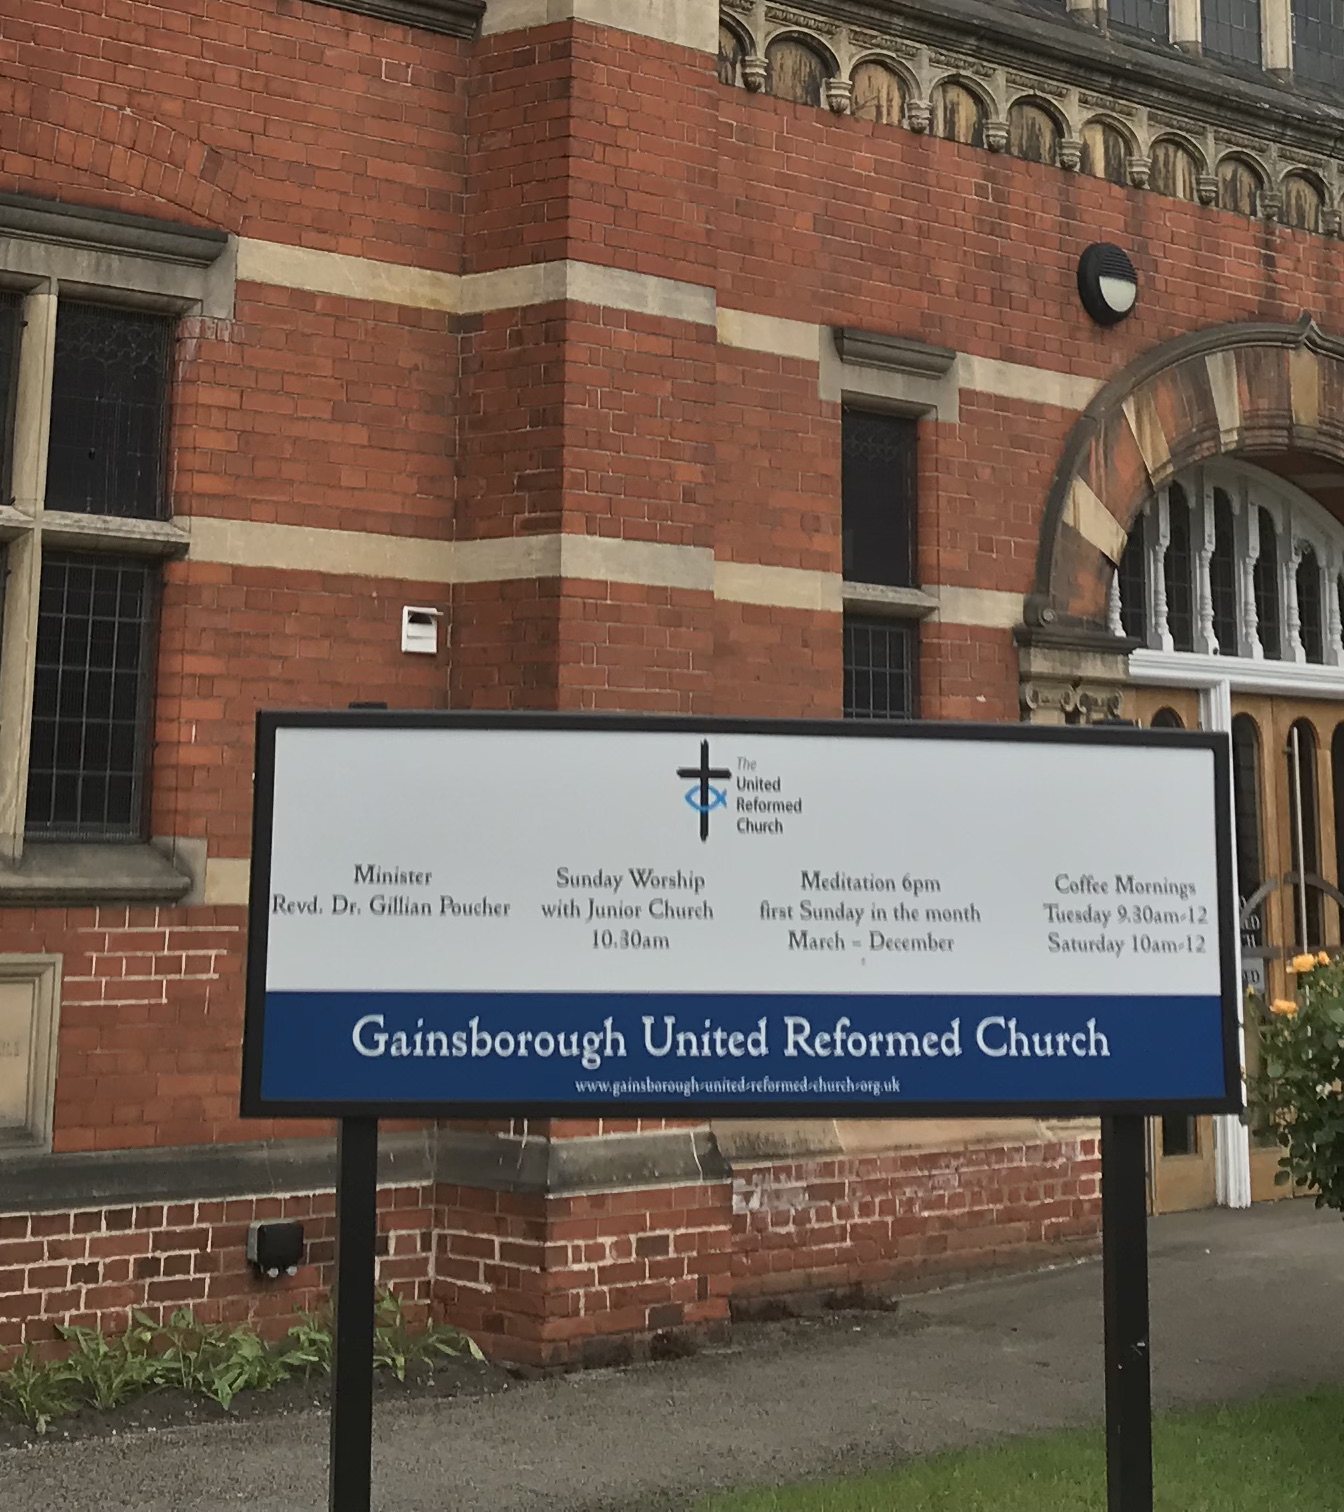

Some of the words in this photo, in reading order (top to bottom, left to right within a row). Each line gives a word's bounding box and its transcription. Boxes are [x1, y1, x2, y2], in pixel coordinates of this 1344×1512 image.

[736, 755, 757, 771] The
[736, 775, 781, 793] United
[736, 795, 802, 814] Reformed
[736, 816, 783, 835] Church
[353, 863, 433, 886] Minister
[556, 865, 624, 894] Sunday
[627, 867, 706, 895] Worship
[800, 869, 897, 892] Meditation
[901, 872, 942, 897] 6pm
[1054, 872, 1109, 895] Coffee
[1114, 874, 1197, 901] Mornings
[272, 893, 323, 916] Revd.
[331, 893, 362, 916] Dr.
[368, 893, 433, 917] Gillian
[439, 894, 511, 917] Poucher
[540, 898, 581, 919] with
[584, 897, 643, 925] Junior
[648, 897, 714, 920] Church
[759, 899, 794, 921] first
[799, 899, 865, 927] Sunday
[870, 901, 888, 922] in
[893, 901, 920, 922] the
[925, 902, 982, 923] month
[1042, 902, 1112, 929] Tuesday
[592, 928, 671, 950] 10.30am
[787, 929, 846, 951] March
[868, 929, 955, 952] December
[1047, 931, 1126, 959] Saturday
[351, 1013, 628, 1070] Gainsborough
[641, 1015, 770, 1058] United
[782, 1015, 963, 1058] Reformed
[975, 1015, 1111, 1058] Church
